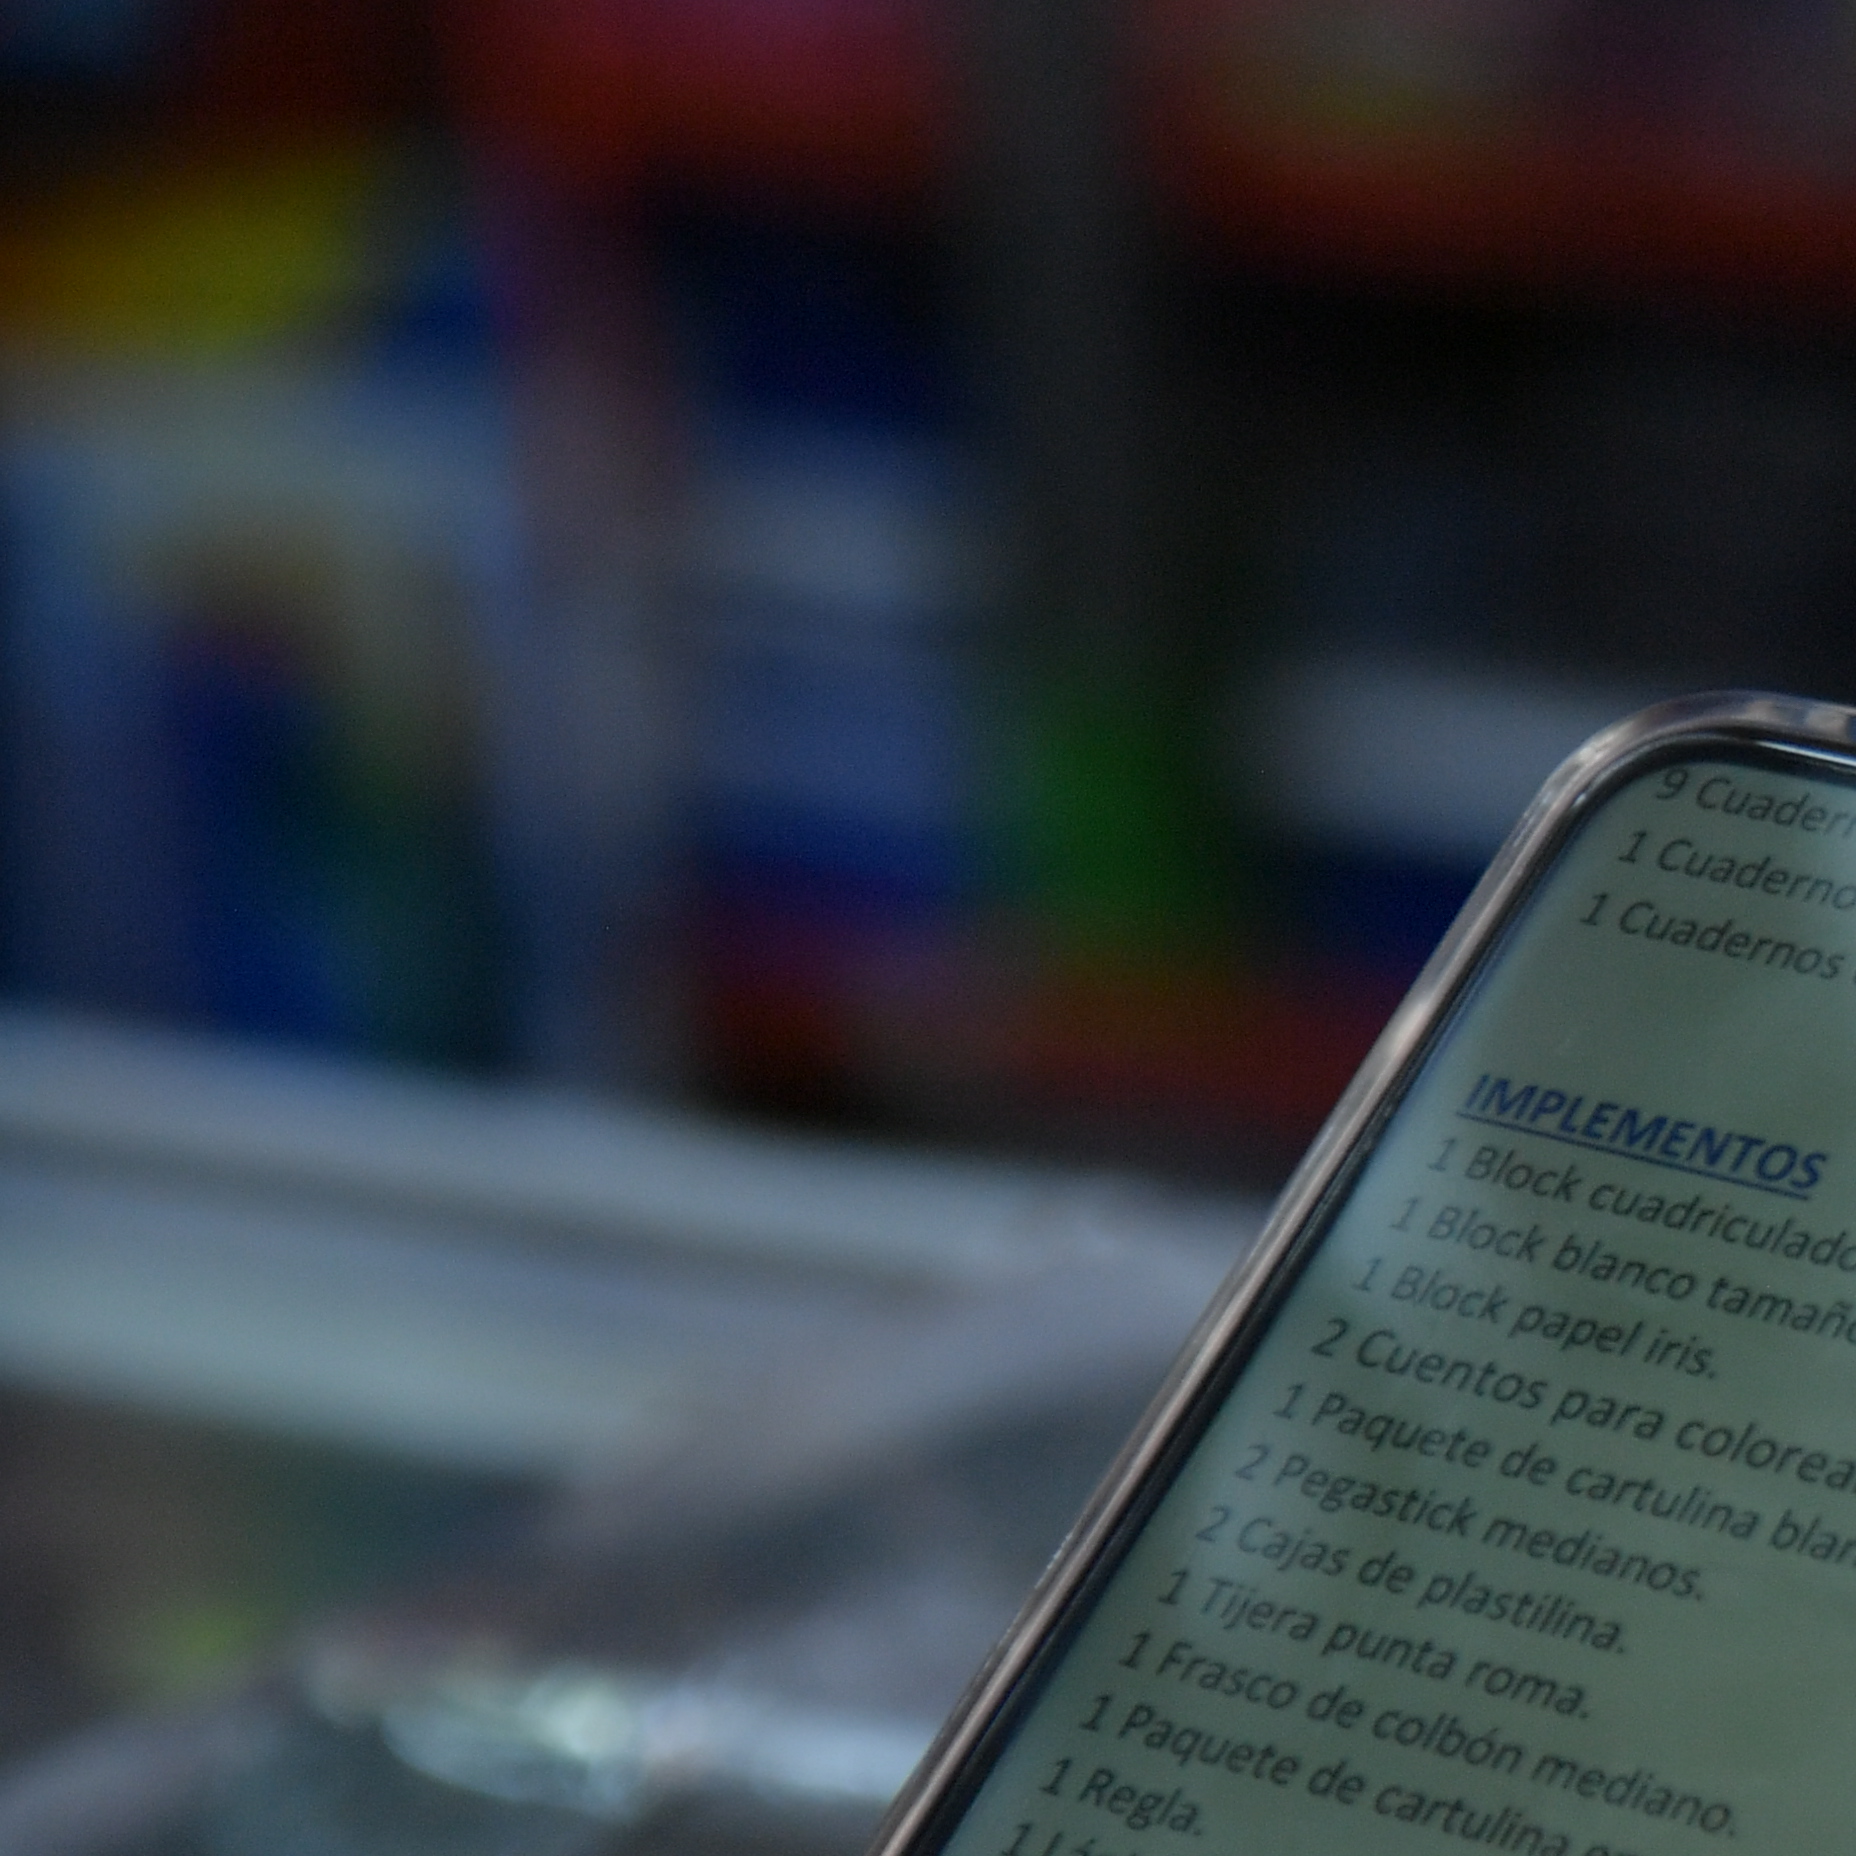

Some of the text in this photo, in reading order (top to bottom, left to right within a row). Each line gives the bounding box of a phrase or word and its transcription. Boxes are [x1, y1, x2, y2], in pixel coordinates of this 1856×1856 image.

[1654, 761, 1694, 800] 9
[1617, 828, 1651, 865] 1
[1617, 898, 1846, 980] Cuadernos
[1429, 1137, 1456, 1171] 1
[1465, 1144, 1583, 1203] Block
[1457, 1070, 1832, 1200] IMPLEMENTOS
[1427, 1205, 1548, 1264] Block
[1550, 1232, 1700, 1301] blanco
[1309, 1315, 1352, 1358] 2
[1353, 1328, 1549, 1410] Cuentos
[1548, 1387, 1668, 1441] para
[1390, 1265, 1717, 1380] Block papel iris.
[1234, 1443, 1704, 1602] 2 Pegastick medianos.
[1311, 1390, 1494, 1469] Paquete
[1498, 1440, 1559, 1487] de
[1564, 1466, 1761, 1540] cartulina
[1195, 1506, 1626, 1655] 2 Cajas de plastilina.
[1201, 1577, 1590, 1720] Tijera punta roma.
[1116, 1701, 1302, 1787] Paquete
[1306, 1757, 1368, 1806] de
[1155, 1639, 1737, 1838] Frasco de colbón mediano.
[1076, 1765, 1203, 1837] Regla.
